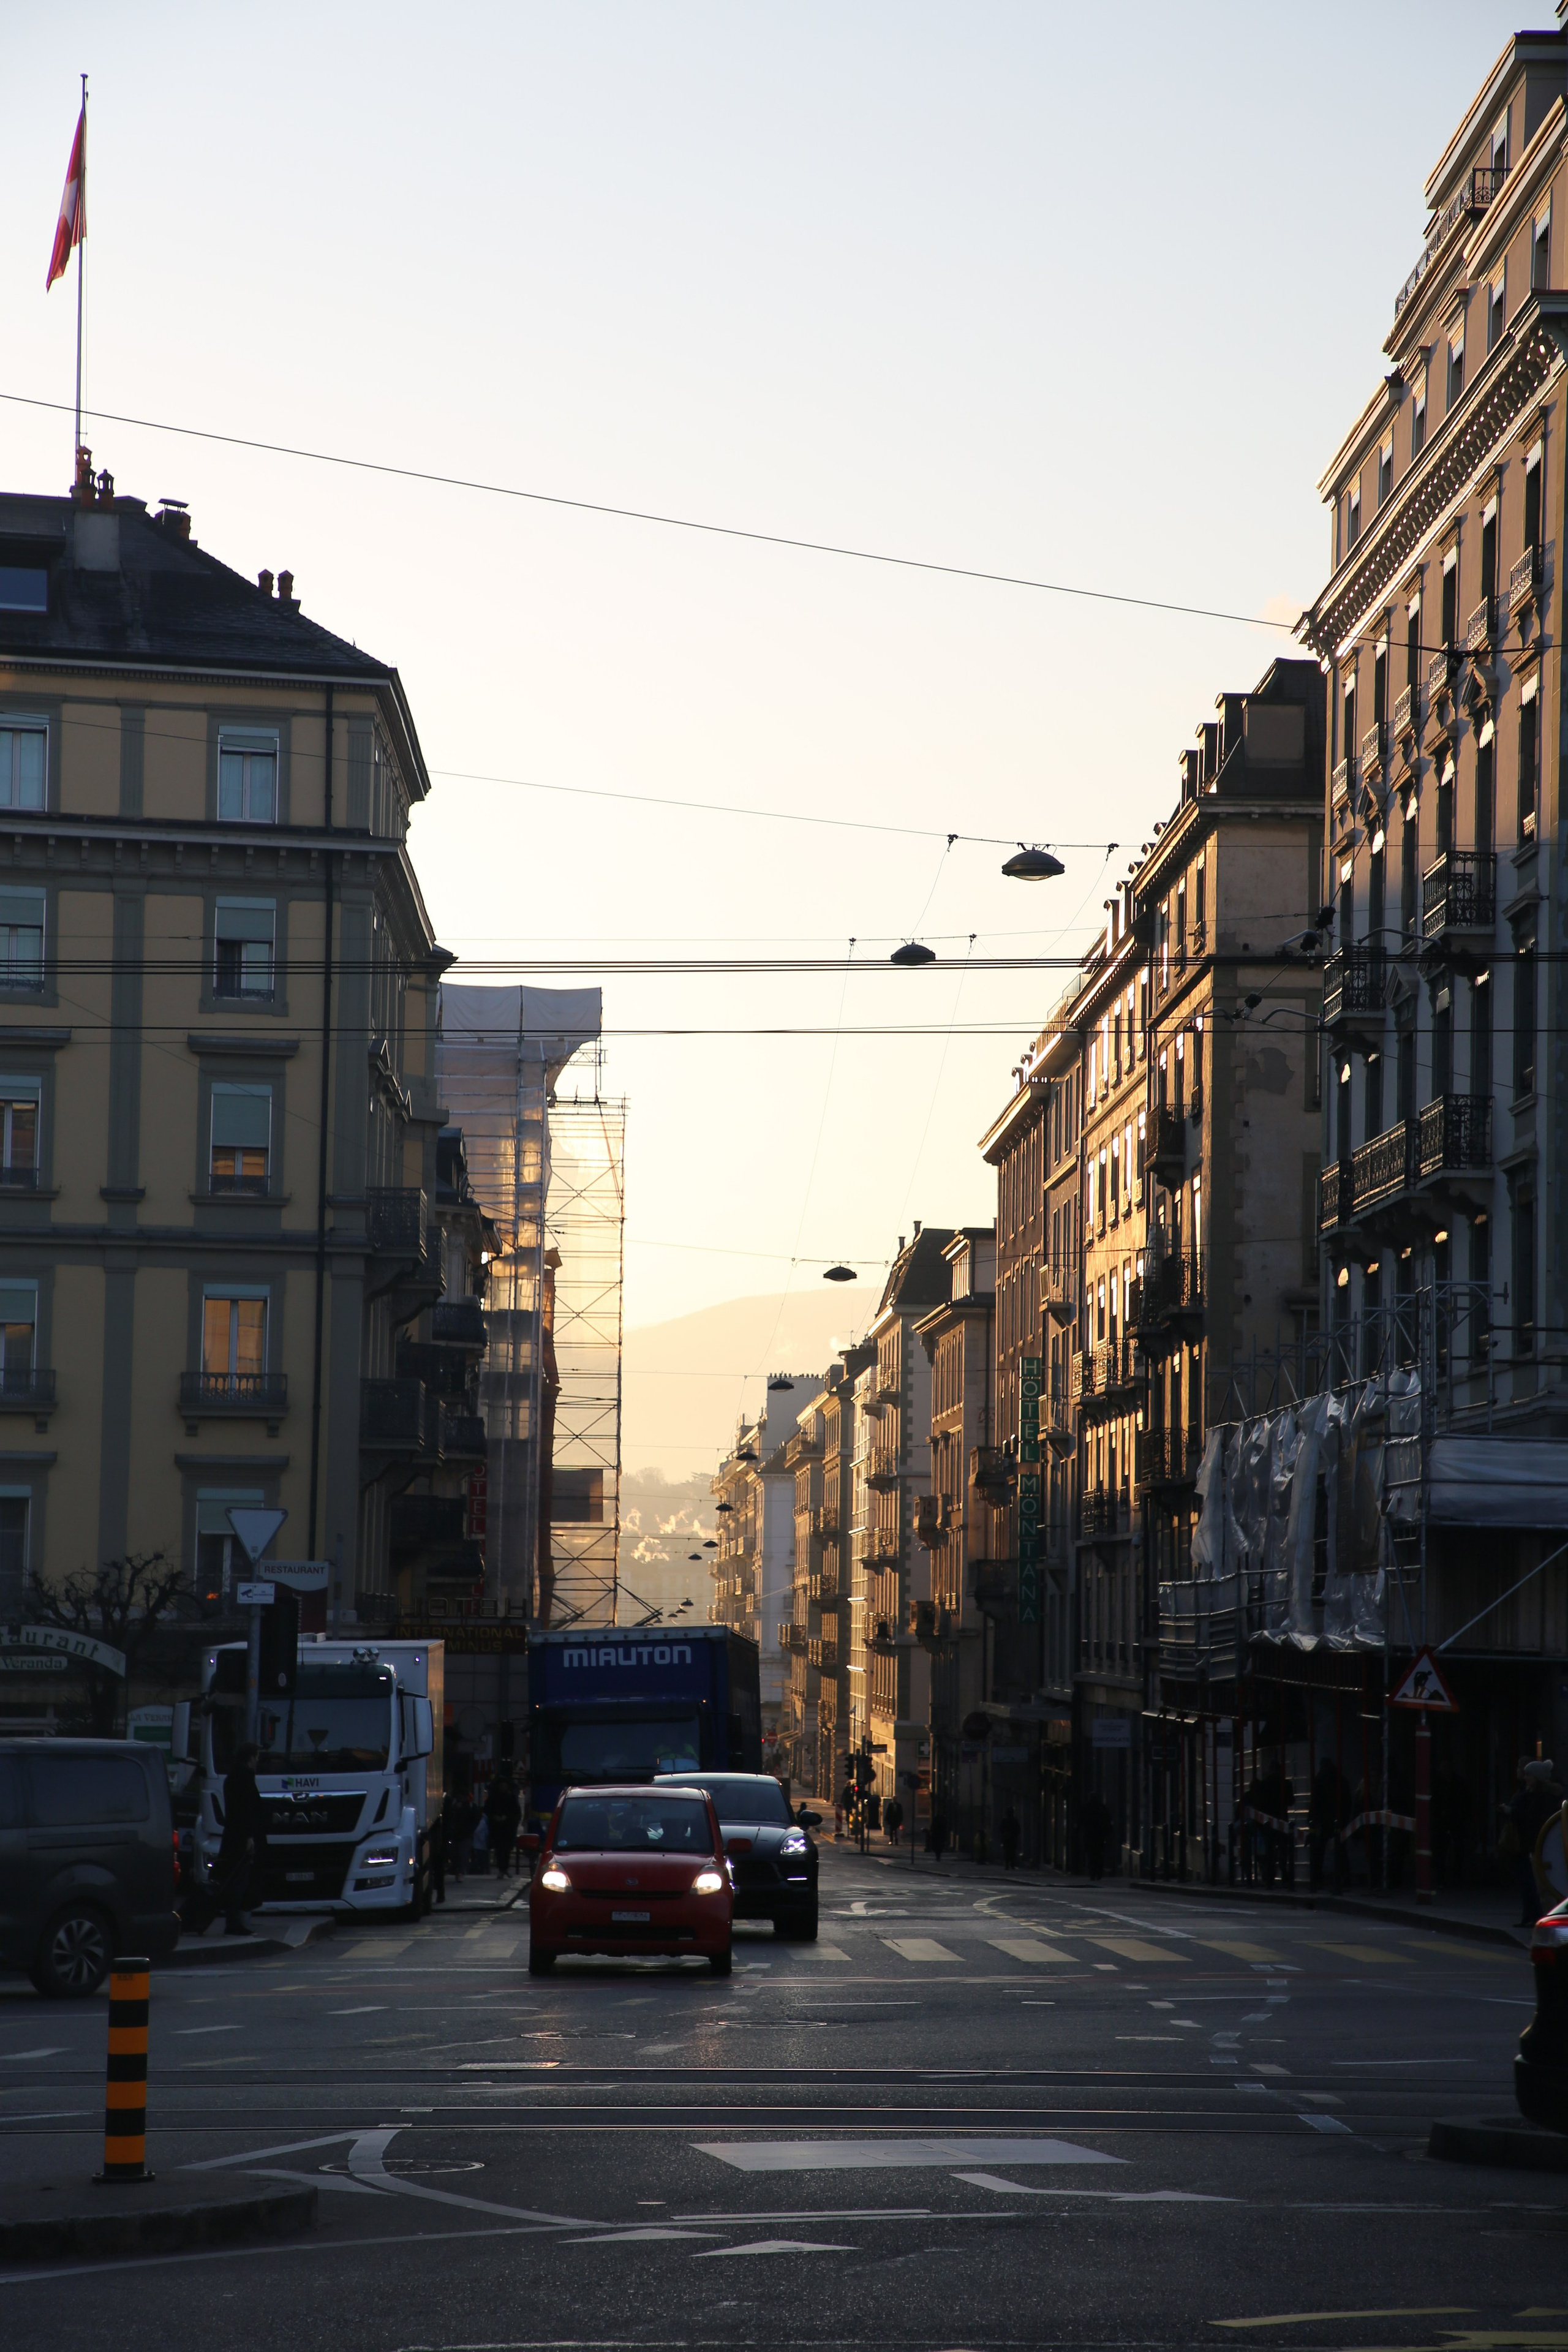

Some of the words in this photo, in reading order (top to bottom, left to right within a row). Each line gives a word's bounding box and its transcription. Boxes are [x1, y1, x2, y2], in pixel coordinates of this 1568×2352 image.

[1023, 1359, 1038, 1461] HOTEL
[473, 1465, 485, 1532] OTEL
[1021, 1477, 1036, 1622] MONTANA
[264, 1566, 325, 1574] RESTAURANT
[396, 1626, 522, 1639] INTERNATIONAL
[447, 1640, 503, 1653] MINUS
[563, 1645, 692, 1668] MIAUTON
[295, 1777, 319, 1787] HAVI
[272, 1811, 328, 1823] MAN
